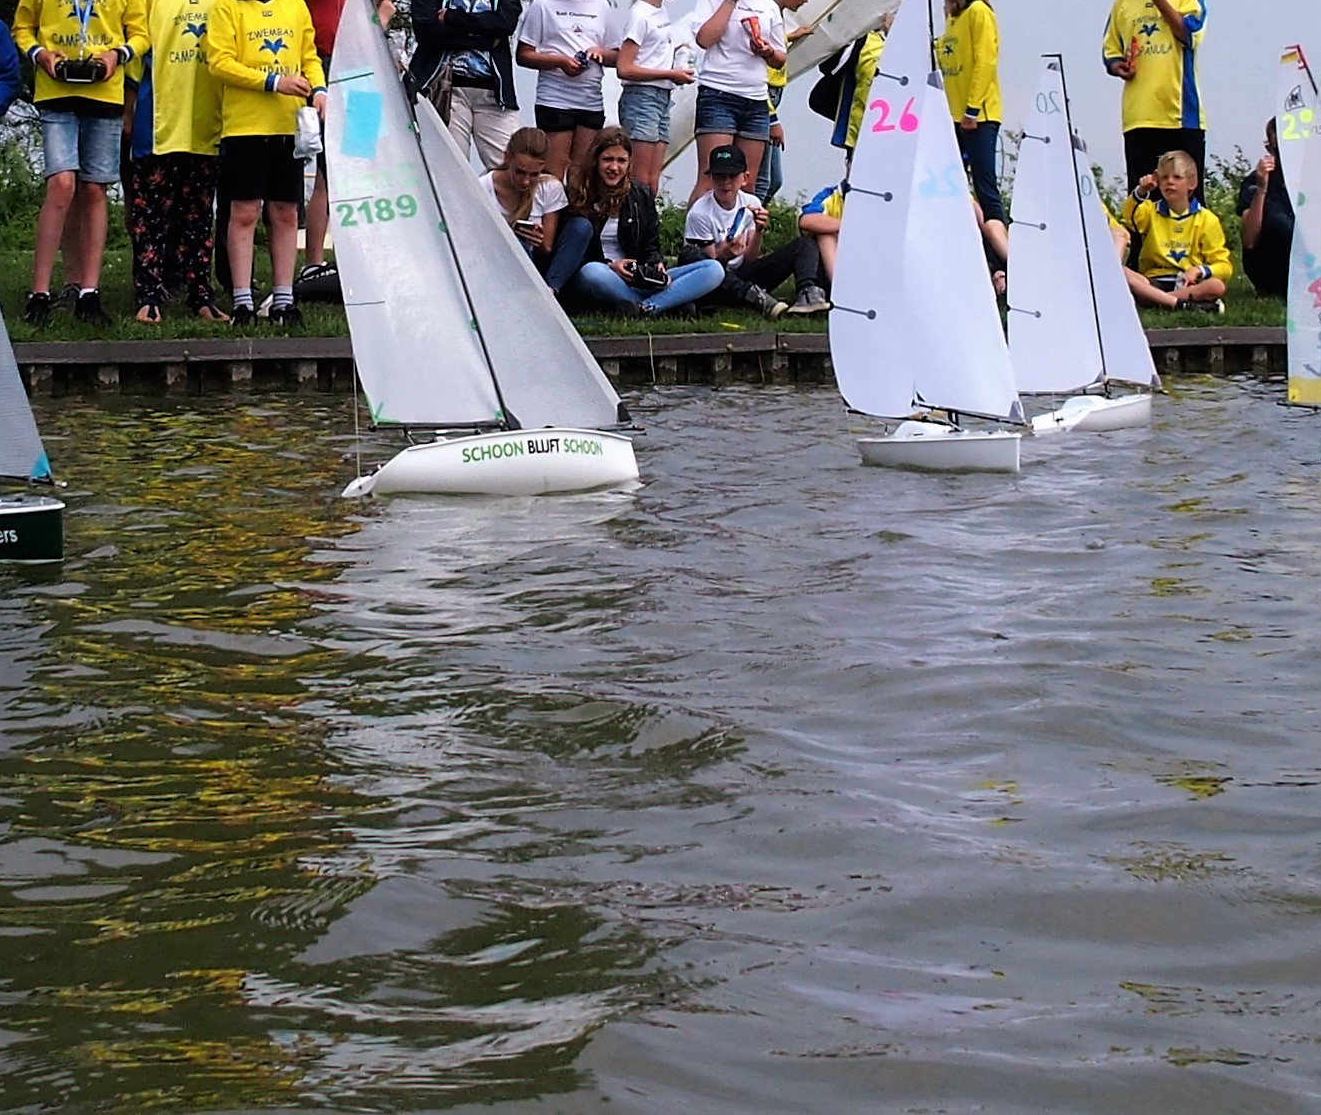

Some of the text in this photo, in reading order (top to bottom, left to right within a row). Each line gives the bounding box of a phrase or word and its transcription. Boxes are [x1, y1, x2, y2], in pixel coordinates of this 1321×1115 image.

[870, 97, 918, 132] 26
[336, 194, 418, 226] 2189
[462, 441, 524, 462] SCHOON
[564, 439, 603, 455] SCHOON
